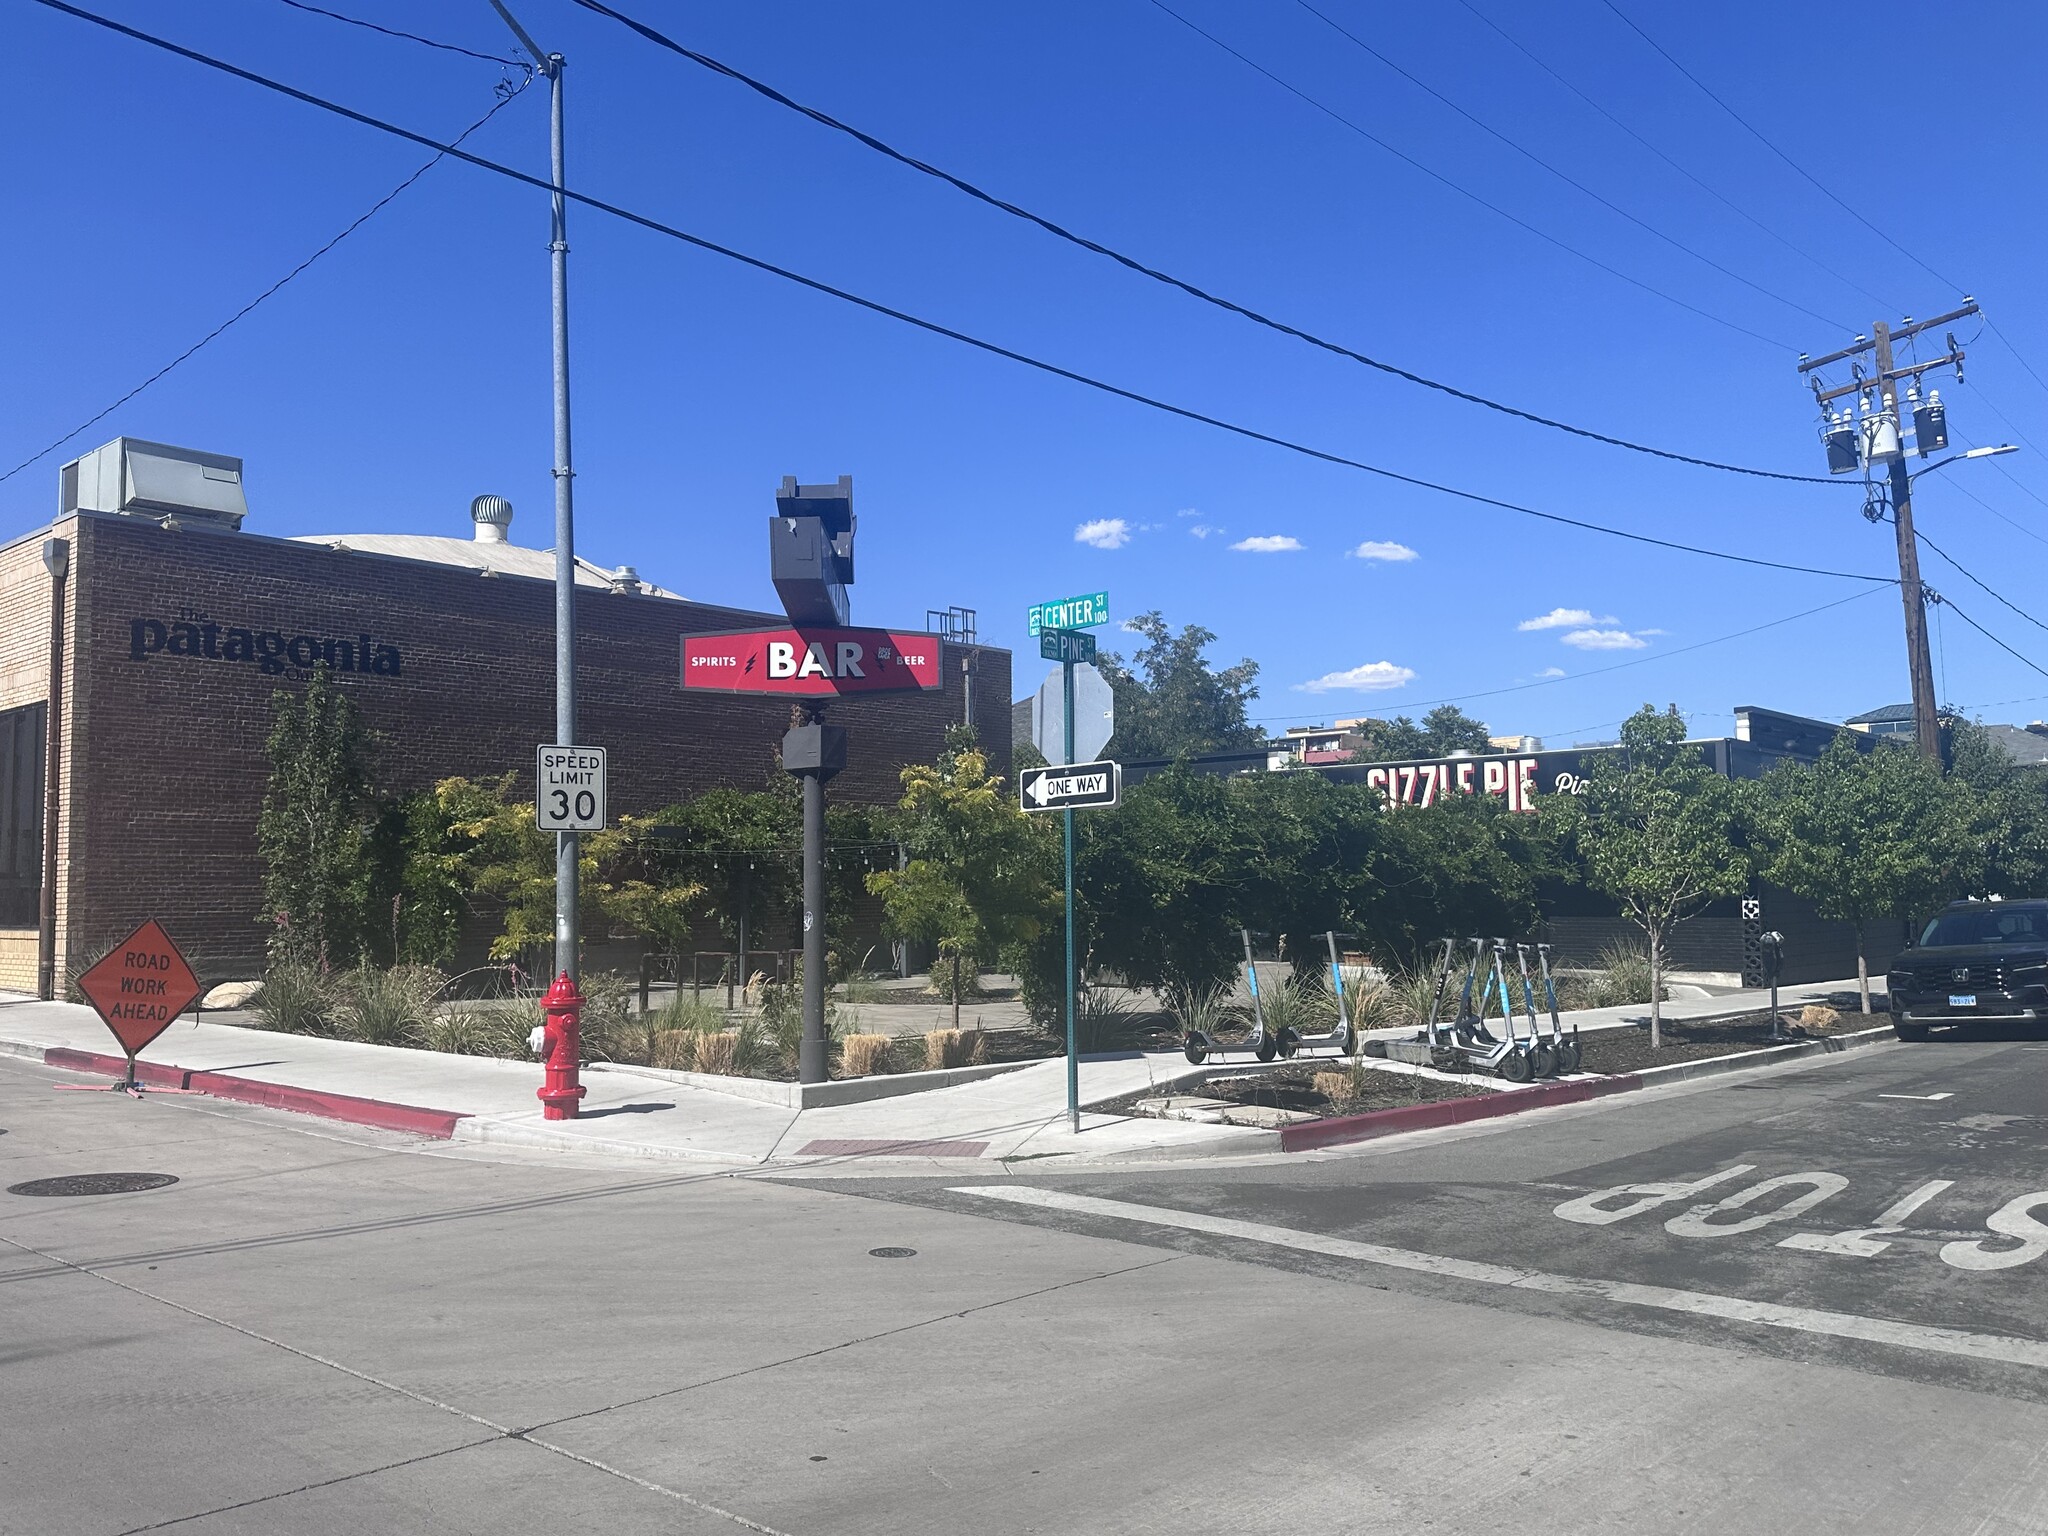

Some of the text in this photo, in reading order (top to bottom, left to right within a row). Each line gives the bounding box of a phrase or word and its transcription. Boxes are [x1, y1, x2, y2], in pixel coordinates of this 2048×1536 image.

[179, 607, 209, 623] The
[1045, 594, 1104, 628] CENTER ST
[1094, 610, 1107, 624] 100
[129, 617, 401, 676] patagonia
[1060, 635, 1085, 661] PINE
[691, 656, 736, 667] SPIRITS
[767, 642, 866, 680] BAR
[896, 655, 926, 666] BEER
[544, 755, 600, 769] SPEED
[550, 771, 594, 785] LIMIT
[1047, 775, 1103, 795] ONE WAY
[1484, 758, 1541, 814] PIE
[549, 789, 596, 821] 30
[125, 951, 171, 971] ROAD
[121, 976, 168, 996] WORK
[110, 1002, 168, 1021] AHEAD
